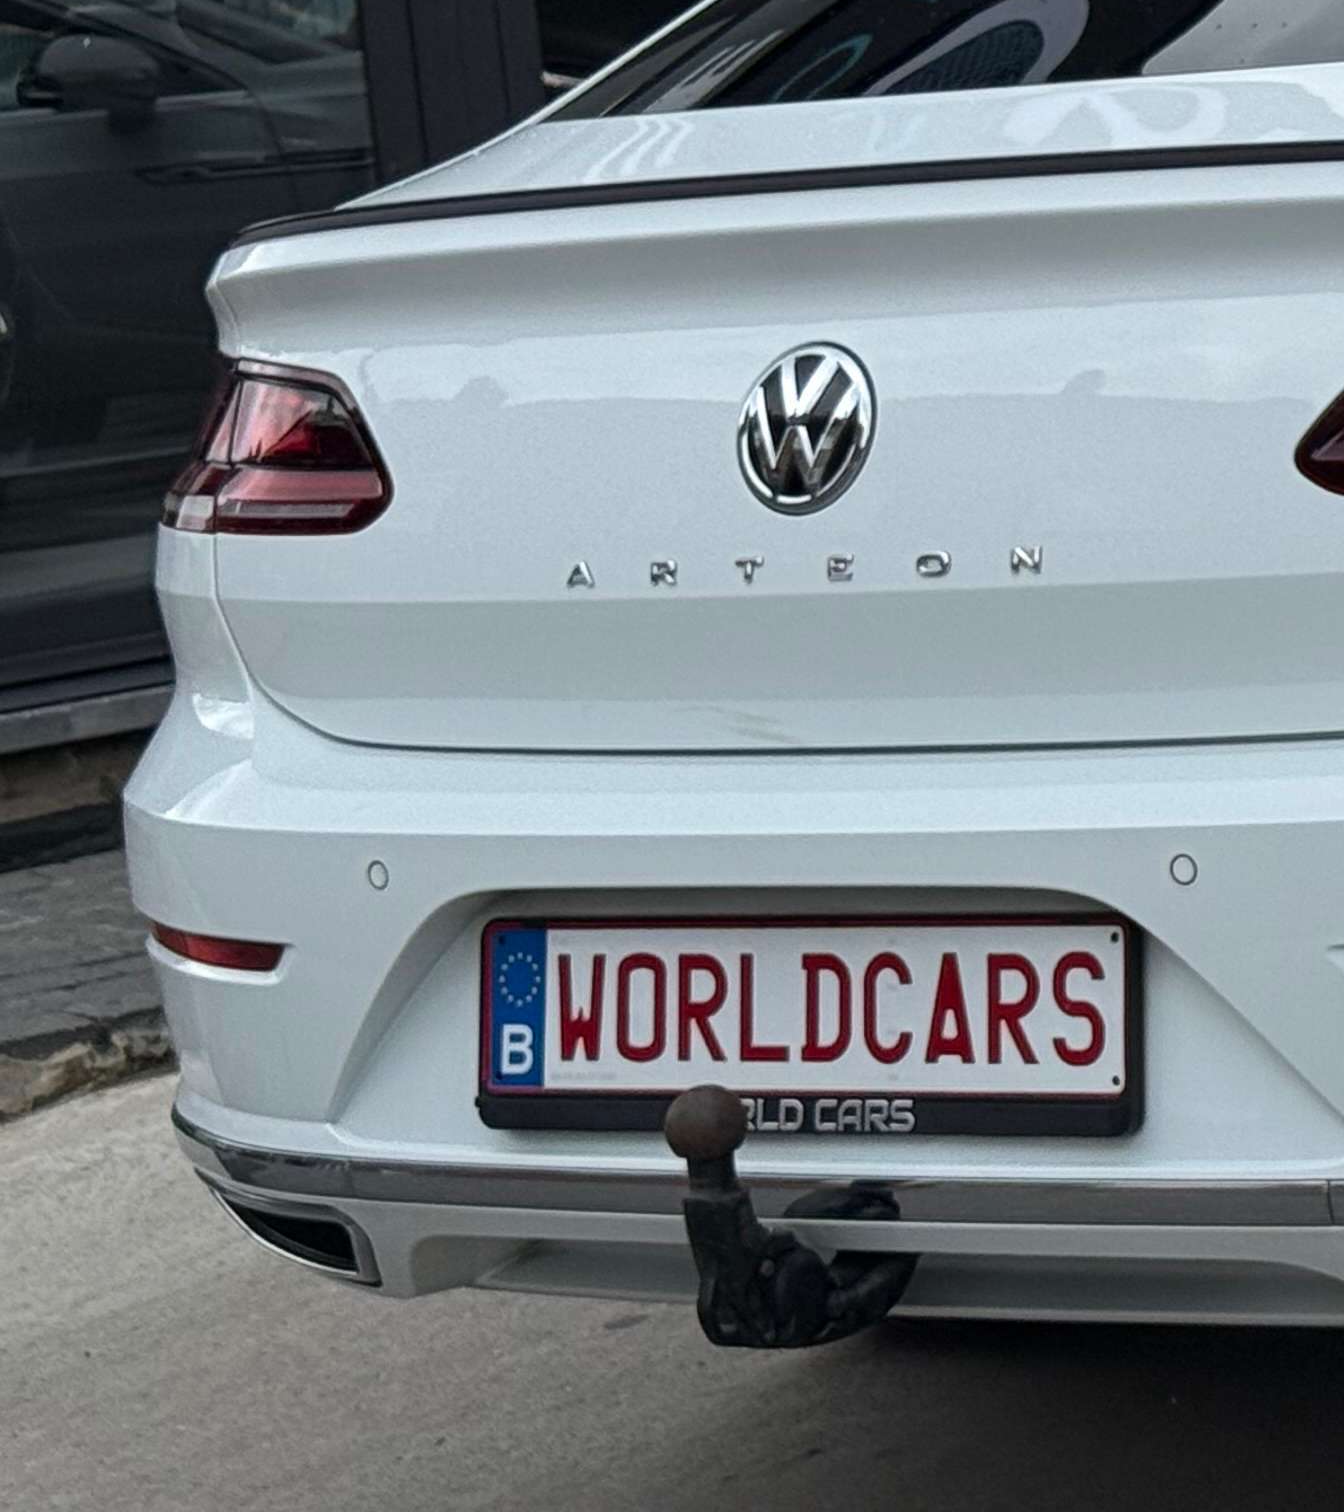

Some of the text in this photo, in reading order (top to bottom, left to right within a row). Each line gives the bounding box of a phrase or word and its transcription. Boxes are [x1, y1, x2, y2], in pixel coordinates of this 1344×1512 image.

[566, 544, 1044, 590] ARTEON
[500, 951, 1106, 1076] B WORLDCARS
[814, 1098, 916, 1134] CARS
